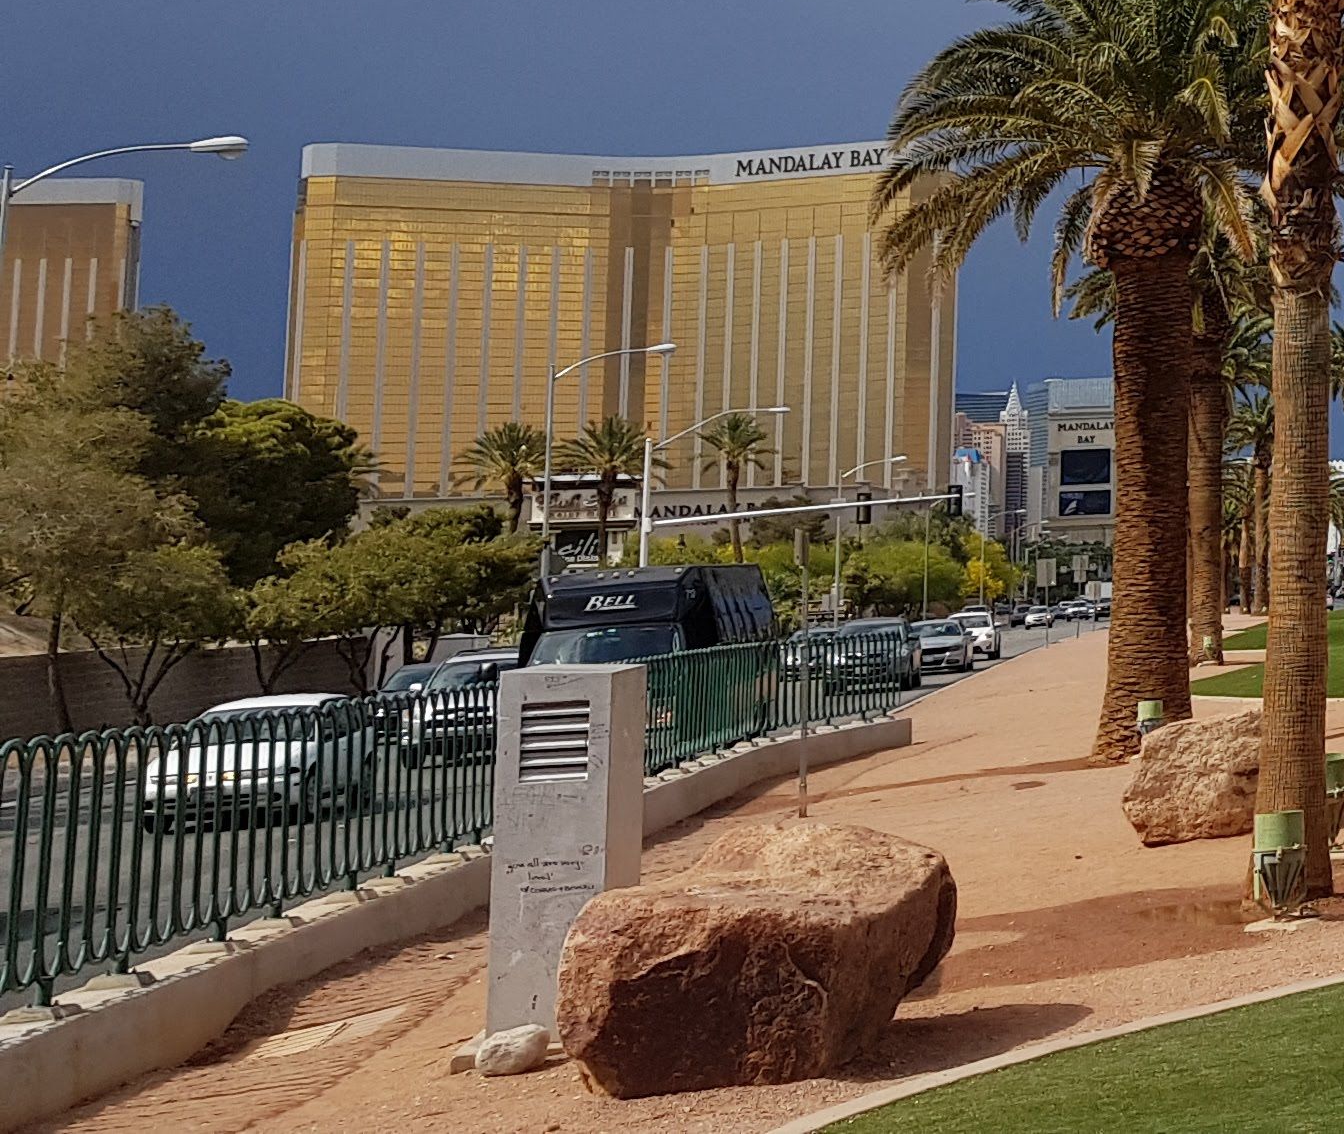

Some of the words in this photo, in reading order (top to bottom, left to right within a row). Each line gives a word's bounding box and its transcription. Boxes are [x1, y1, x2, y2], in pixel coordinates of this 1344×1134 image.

[735, 151, 844, 177] MANDALAY
[850, 148, 887, 168] BAY
[1057, 422, 1114, 432] MANDALAY
[1077, 435, 1096, 444] BAY
[584, 594, 638, 611] BELL
